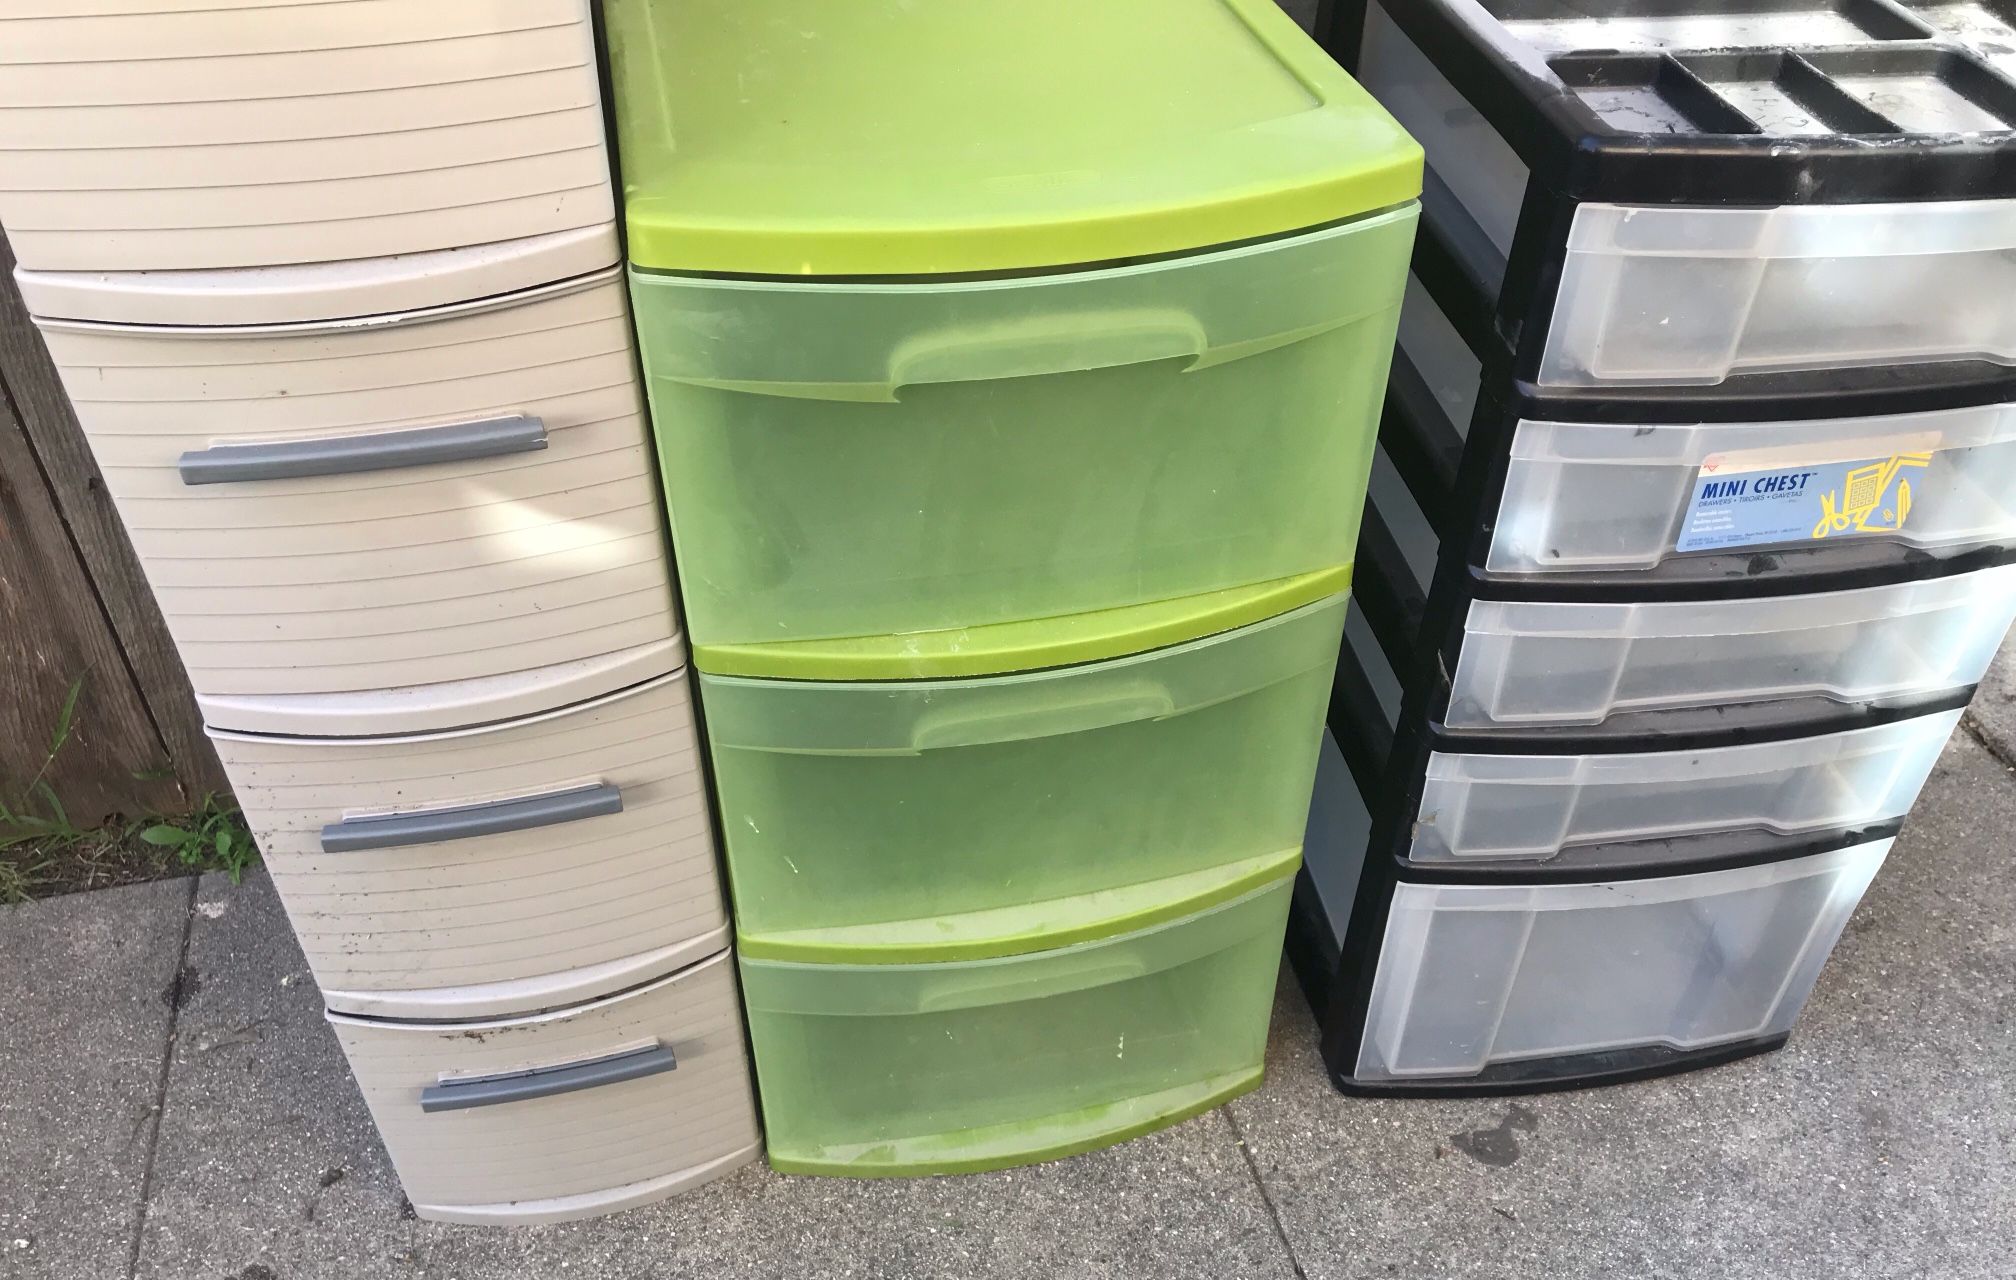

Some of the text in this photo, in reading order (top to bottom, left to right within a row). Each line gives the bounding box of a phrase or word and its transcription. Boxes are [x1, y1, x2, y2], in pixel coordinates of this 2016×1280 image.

[1701, 480, 1747, 499] MINI
[1698, 490, 1803, 508] DRAWERS TIROIRS GAVETAS
